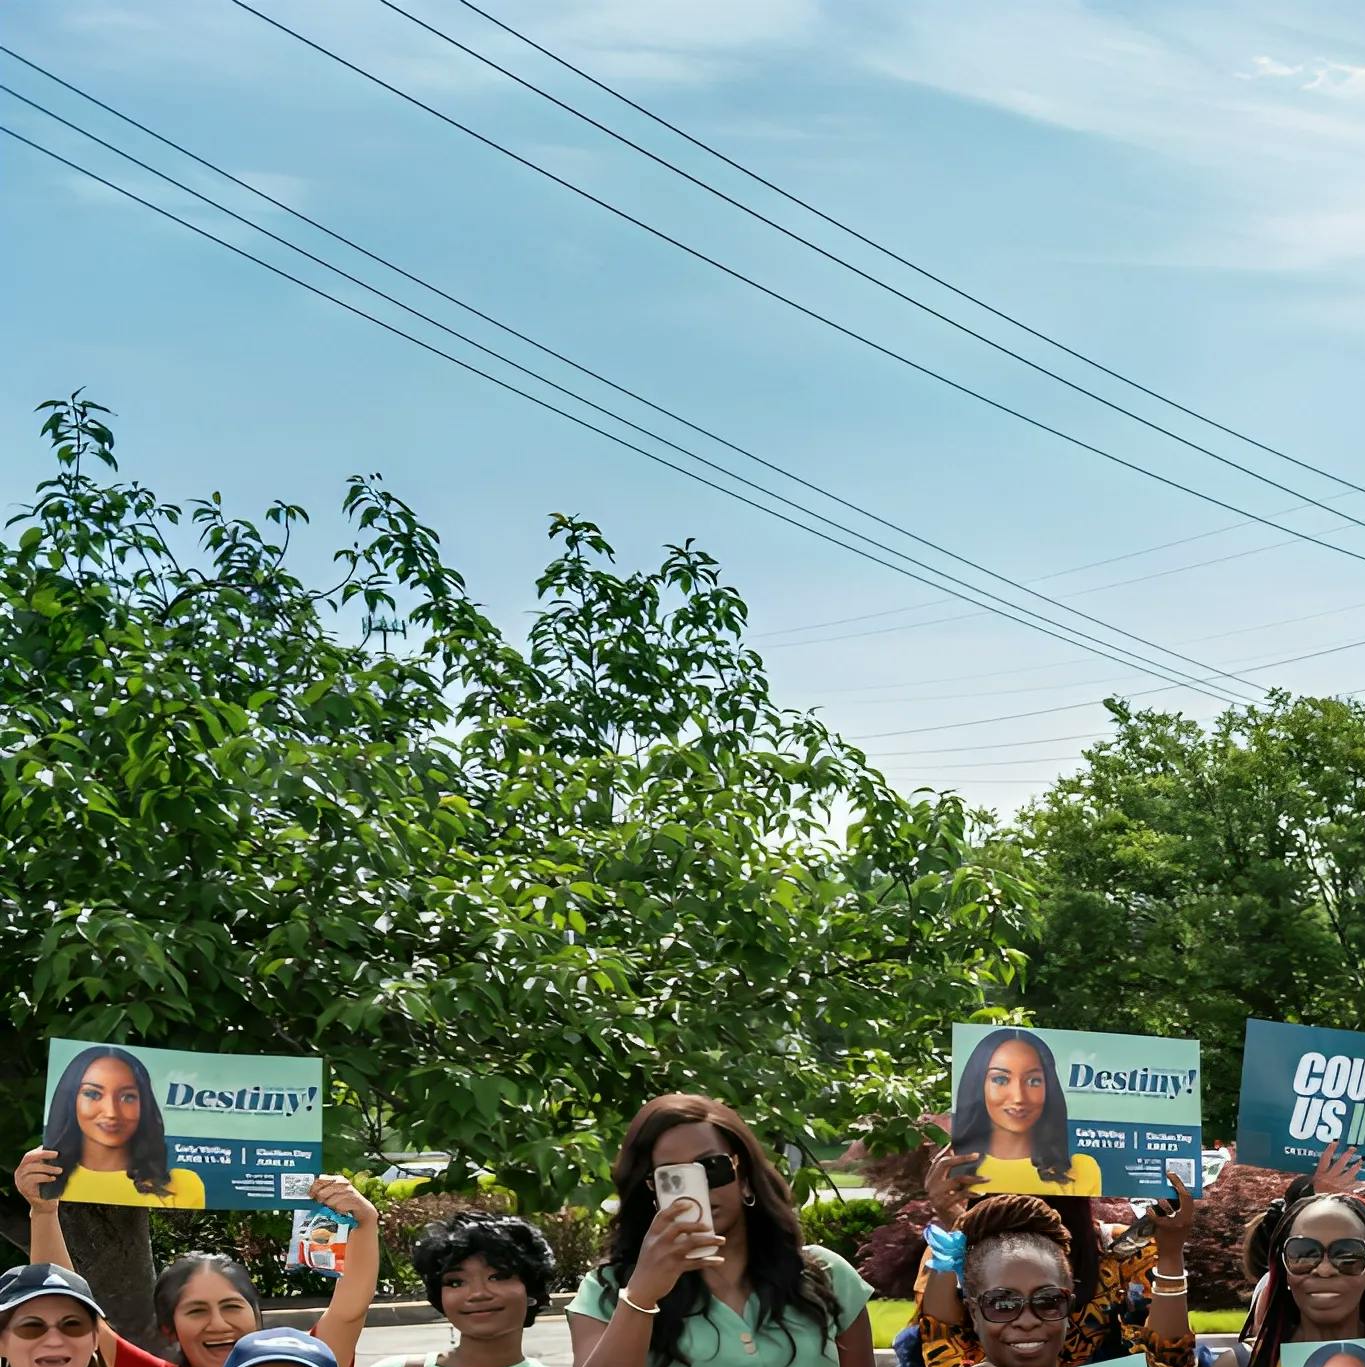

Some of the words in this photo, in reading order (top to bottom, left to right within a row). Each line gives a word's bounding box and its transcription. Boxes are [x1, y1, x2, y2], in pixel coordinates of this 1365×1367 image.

[165, 1082, 318, 1117] Destiny!
[1068, 1063, 1197, 1100] Destiny!
[1289, 1096, 1347, 1143] US
